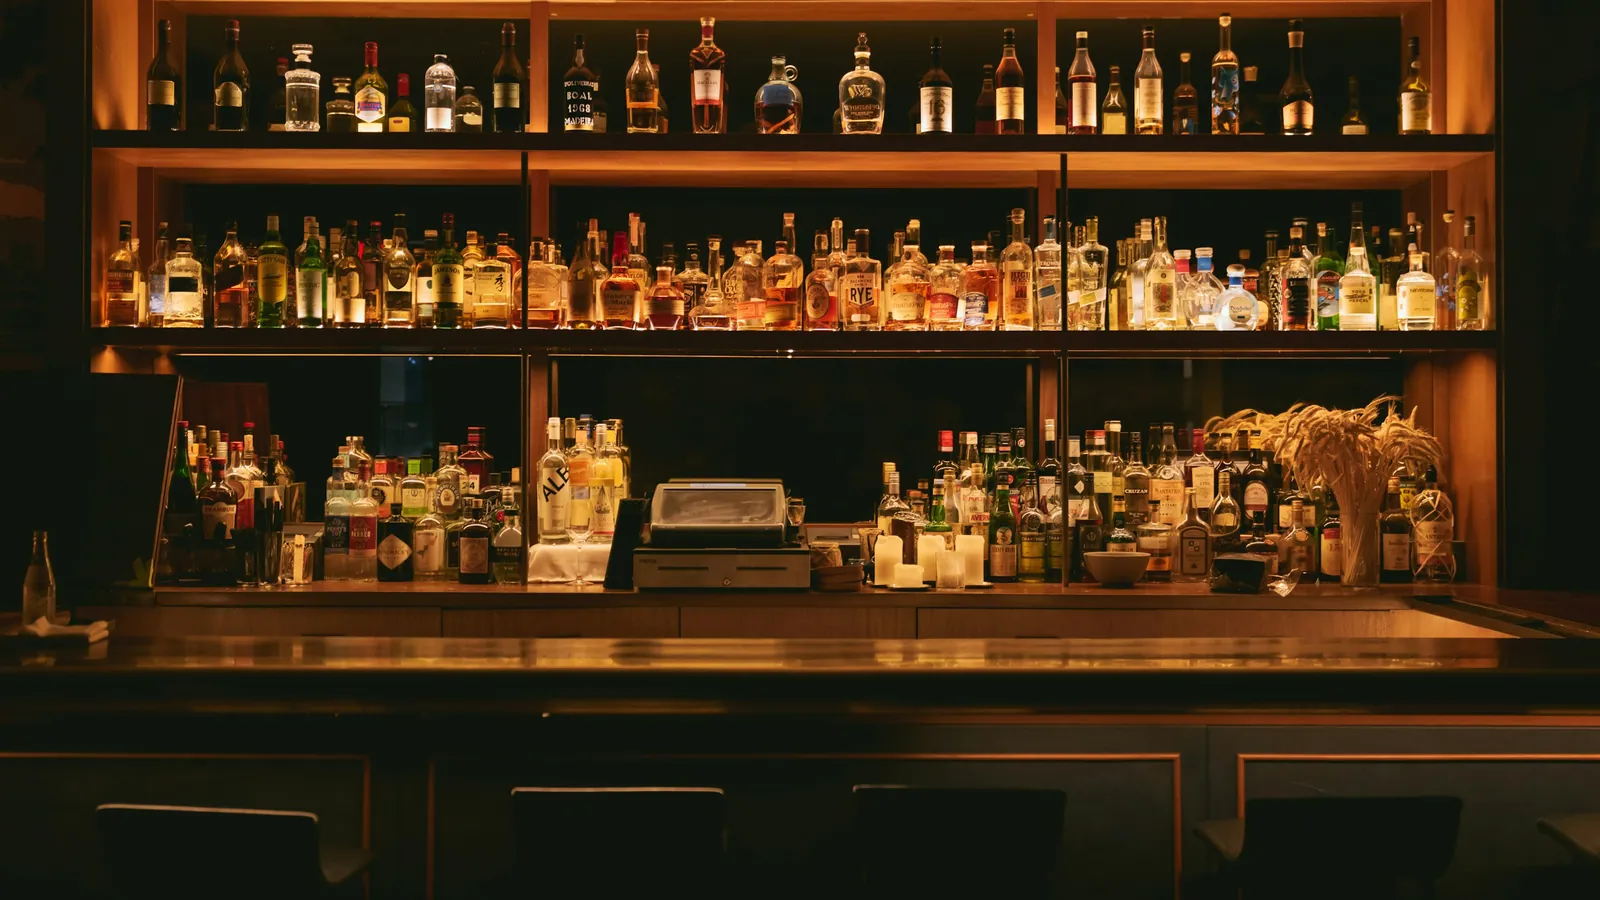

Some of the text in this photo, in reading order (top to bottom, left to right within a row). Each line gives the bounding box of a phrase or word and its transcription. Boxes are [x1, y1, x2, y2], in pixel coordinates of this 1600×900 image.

[566, 91, 593, 101] BOAL
[568, 103, 591, 113] 1968
[564, 116, 594, 126] MADEIRA
[850, 287, 873, 305] RYE
